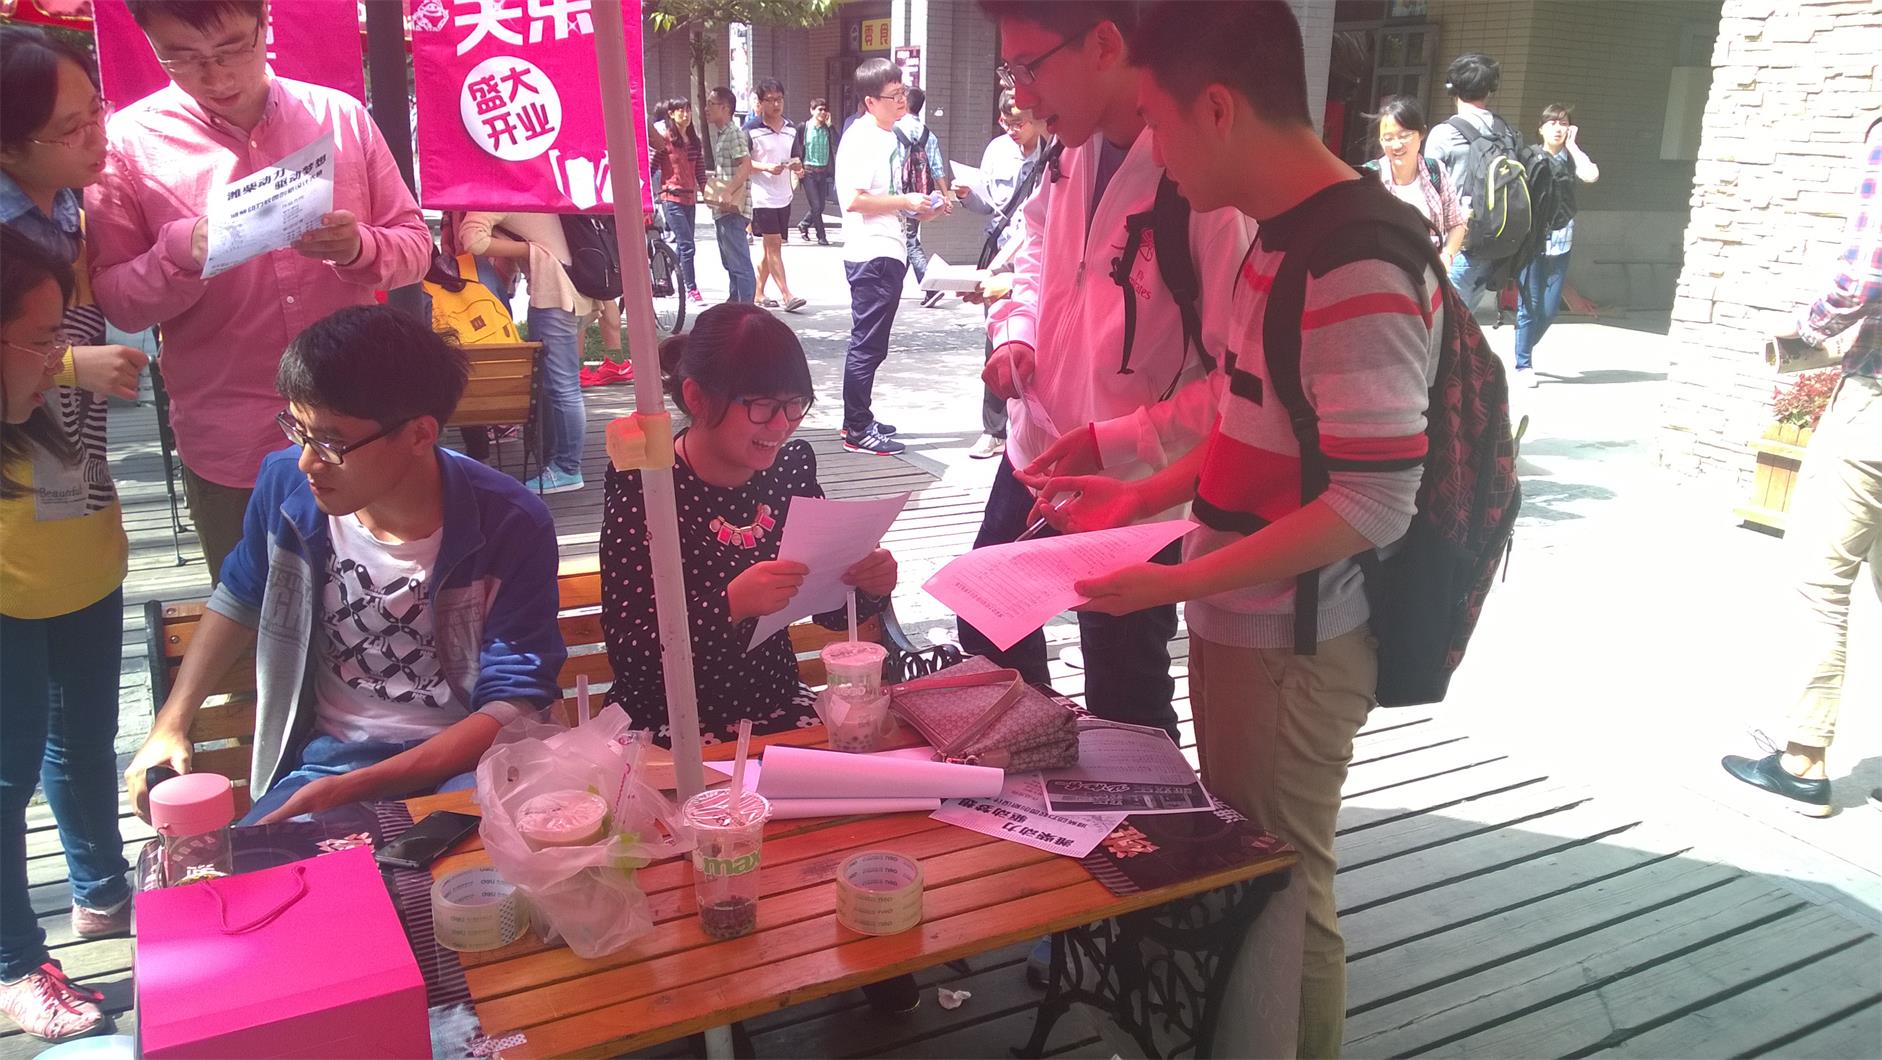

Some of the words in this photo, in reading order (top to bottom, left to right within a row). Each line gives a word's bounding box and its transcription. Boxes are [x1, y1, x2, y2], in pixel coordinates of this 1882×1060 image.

[467, 67, 540, 115] 盛大
[481, 102, 555, 152] 开业
[1002, 822, 1075, 848] 潍柴动力
